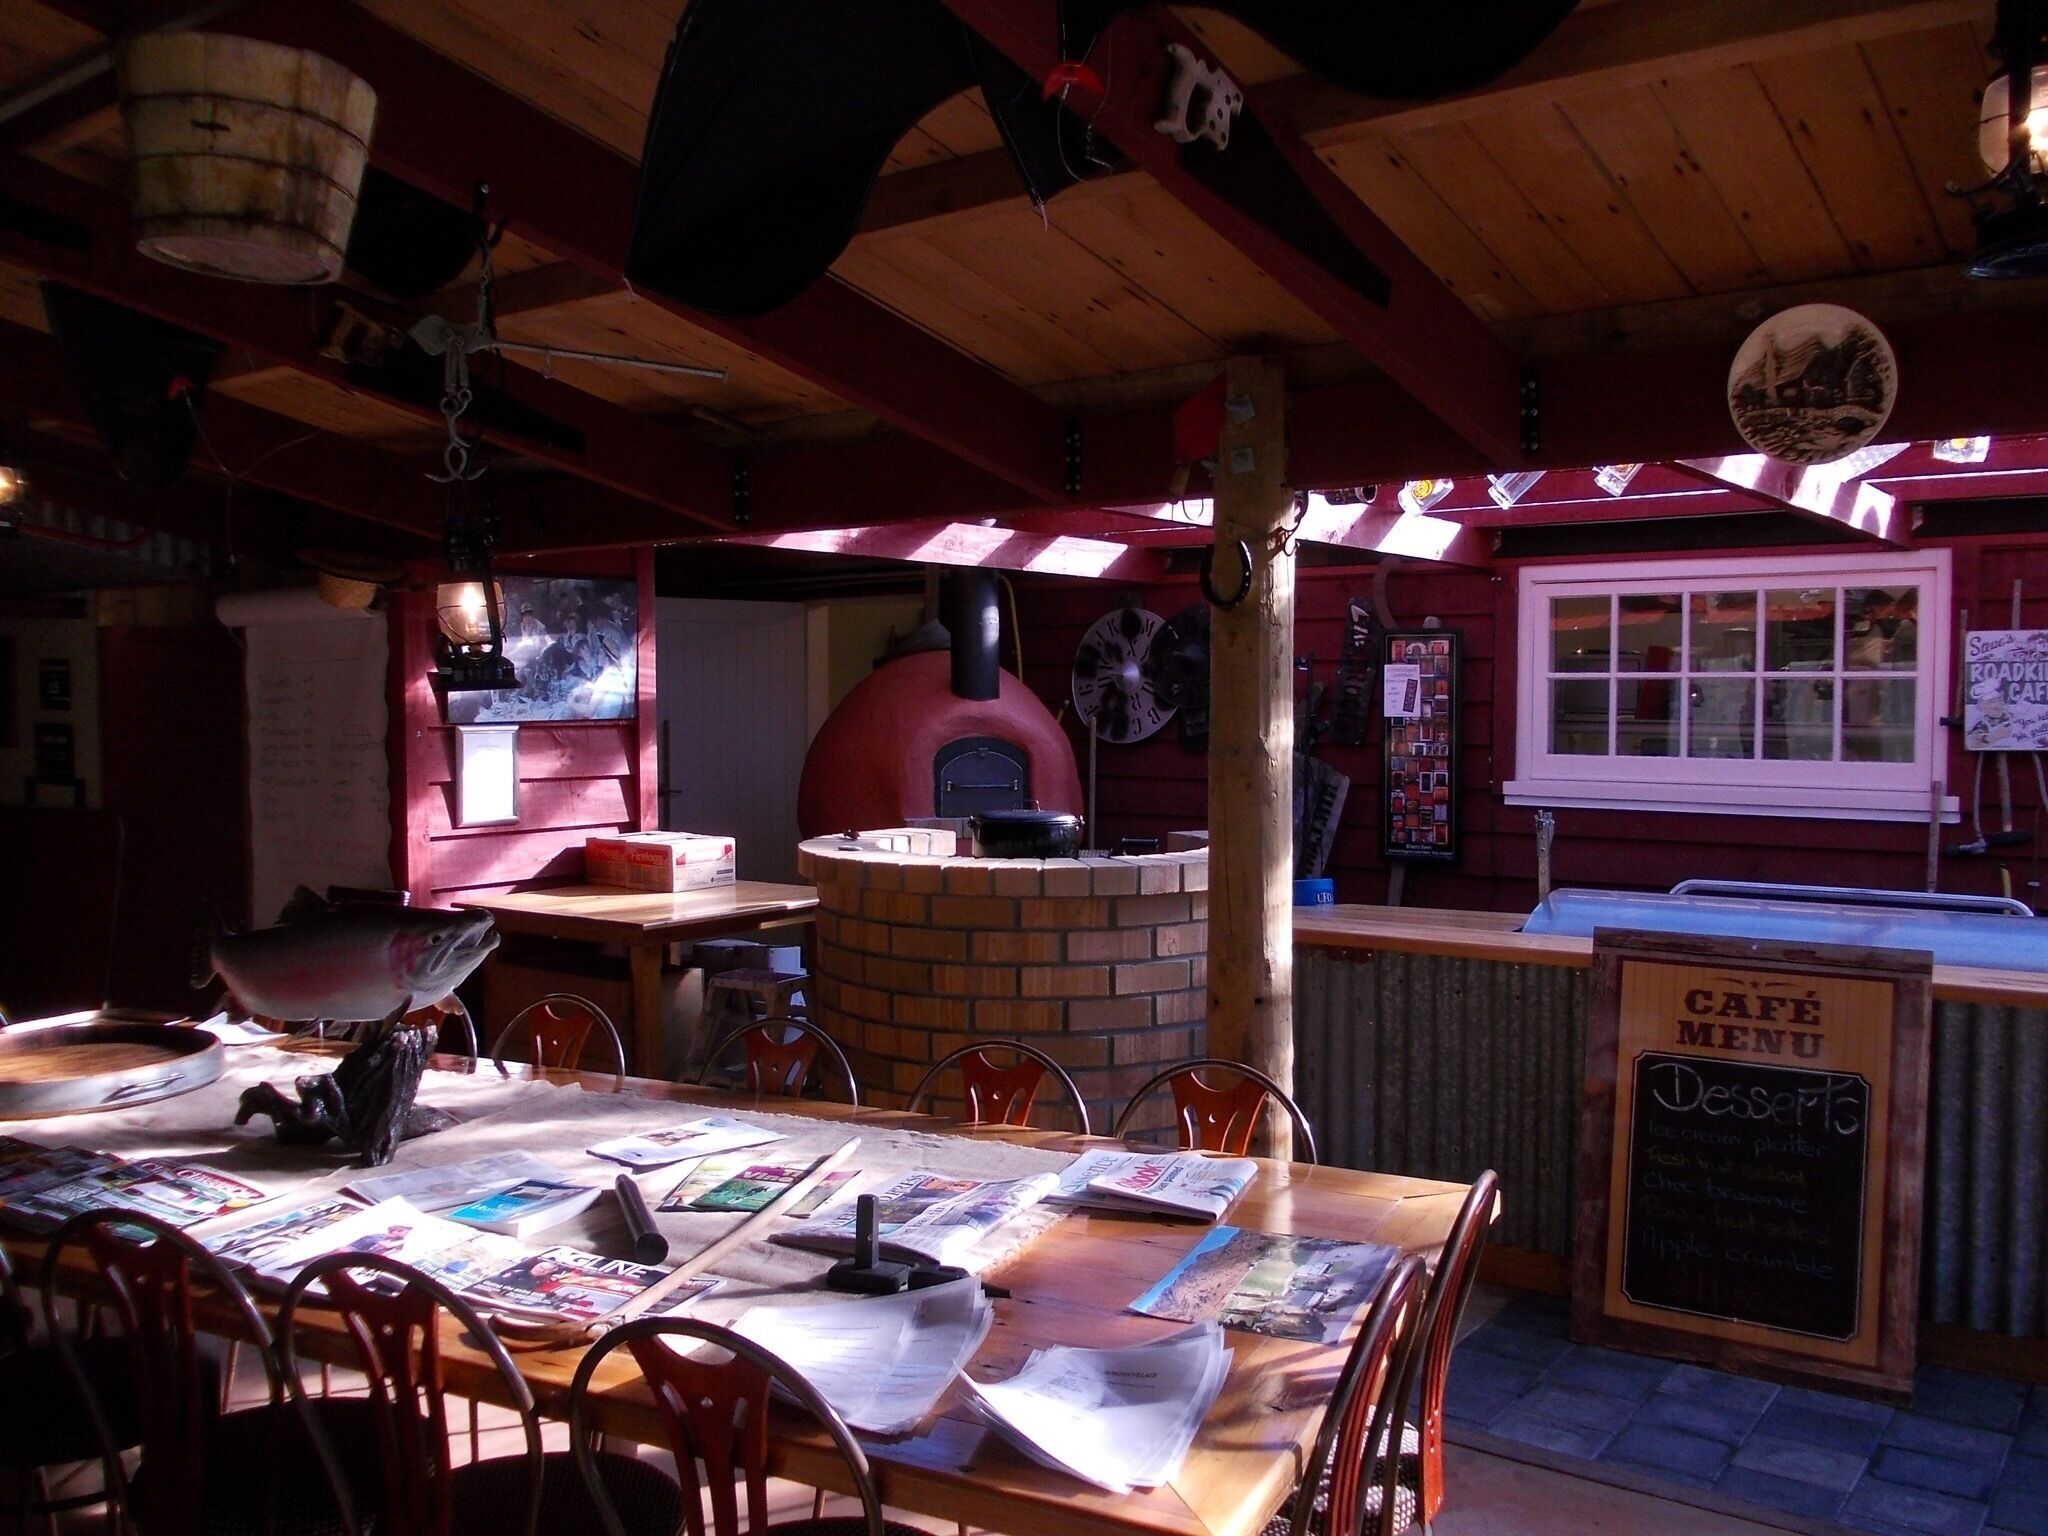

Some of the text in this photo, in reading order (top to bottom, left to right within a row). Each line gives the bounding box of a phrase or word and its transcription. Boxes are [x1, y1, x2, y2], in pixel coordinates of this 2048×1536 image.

[1684, 988, 1822, 1025] CAFÉ
[1676, 1019, 1826, 1058] MENU
[1649, 1061, 1862, 1135] Desserts
[1642, 1226, 1714, 1261] Apple
